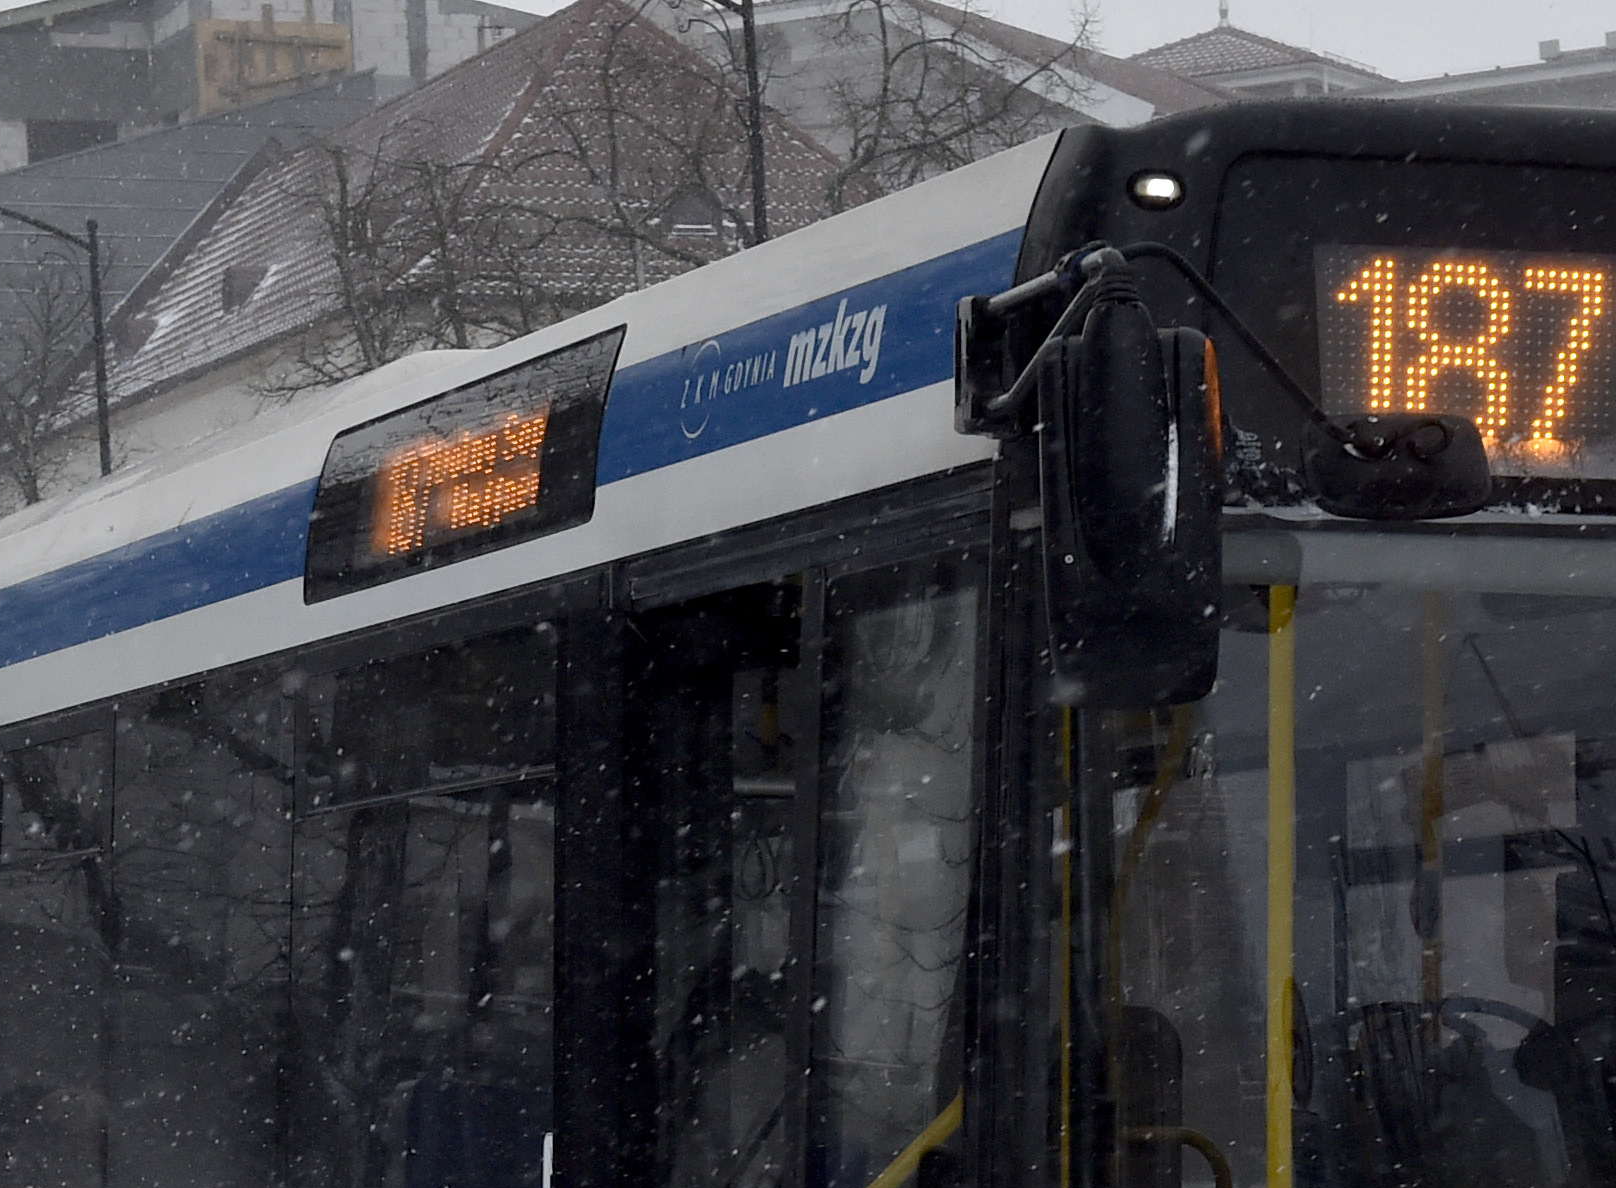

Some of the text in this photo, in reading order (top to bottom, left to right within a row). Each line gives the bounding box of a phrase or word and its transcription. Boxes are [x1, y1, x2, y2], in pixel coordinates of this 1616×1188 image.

[724, 349, 777, 395] GDYNIA
[783, 297, 888, 385] mzkzg
[1337, 257, 1603, 458] 187
